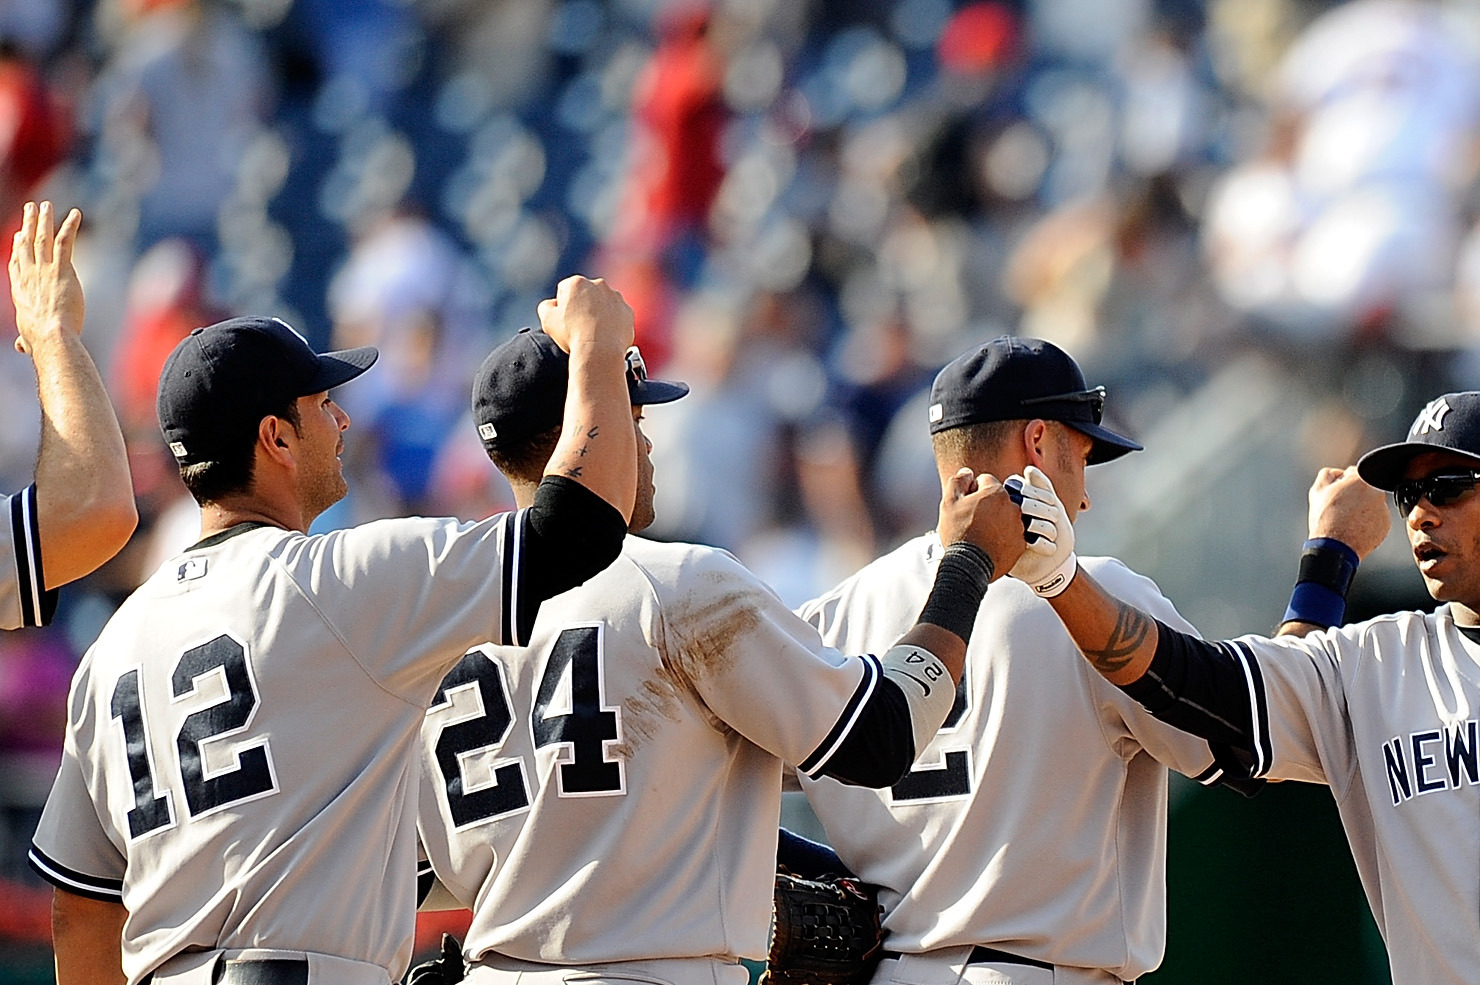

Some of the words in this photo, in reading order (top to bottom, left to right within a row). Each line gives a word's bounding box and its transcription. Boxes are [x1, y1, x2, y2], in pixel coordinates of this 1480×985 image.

[109, 629, 281, 846] 12
[426, 620, 627, 834] 24
[905, 650, 944, 682] 24
